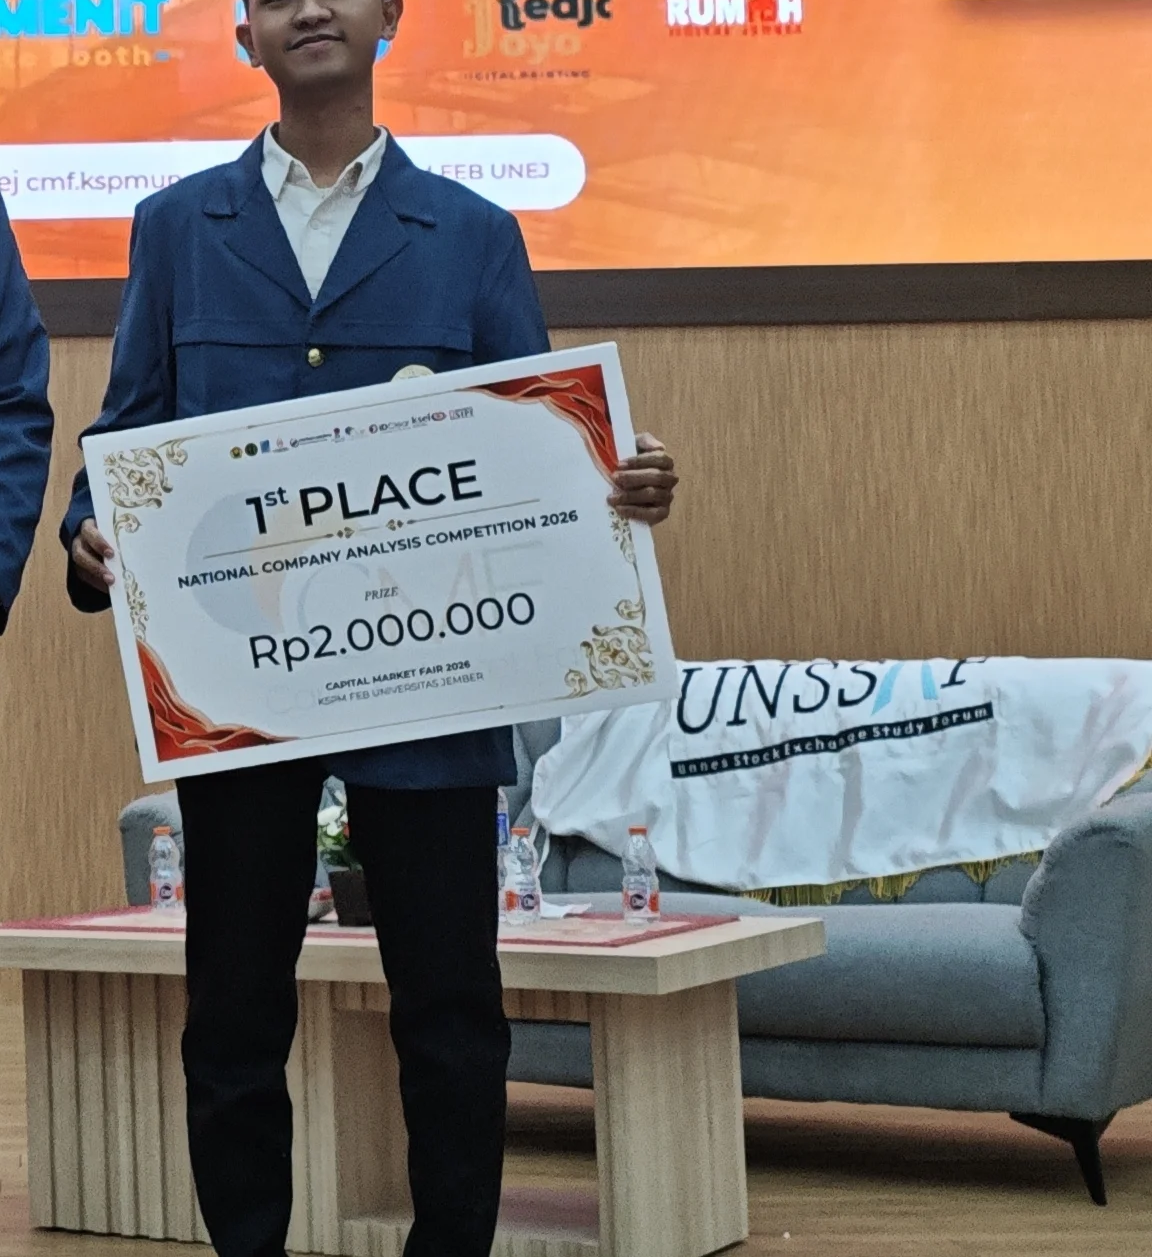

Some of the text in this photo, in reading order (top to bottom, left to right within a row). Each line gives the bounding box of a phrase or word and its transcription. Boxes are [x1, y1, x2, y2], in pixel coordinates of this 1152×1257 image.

[490, 162, 550, 179] UNEJ
[299, 459, 483, 527] PLACE
[177, 510, 579, 589] NATIONAL COMPANY ANALYSIS COMPETITION 2026
[364, 586, 399, 601] PRIZE
[249, 592, 535, 673] Rp2.000.000
[325, 660, 471, 691] CAPITAL MARKET FAIR 2026
[349, 690, 370, 702] FEB
[372, 680, 440, 698] UNIVERSITAS
[441, 671, 484, 688] JEMBER
[677, 759, 729, 775] Unnes
[733, 747, 781, 768] Stock
[873, 721, 925, 738] Study
[931, 707, 988, 729] Forum
